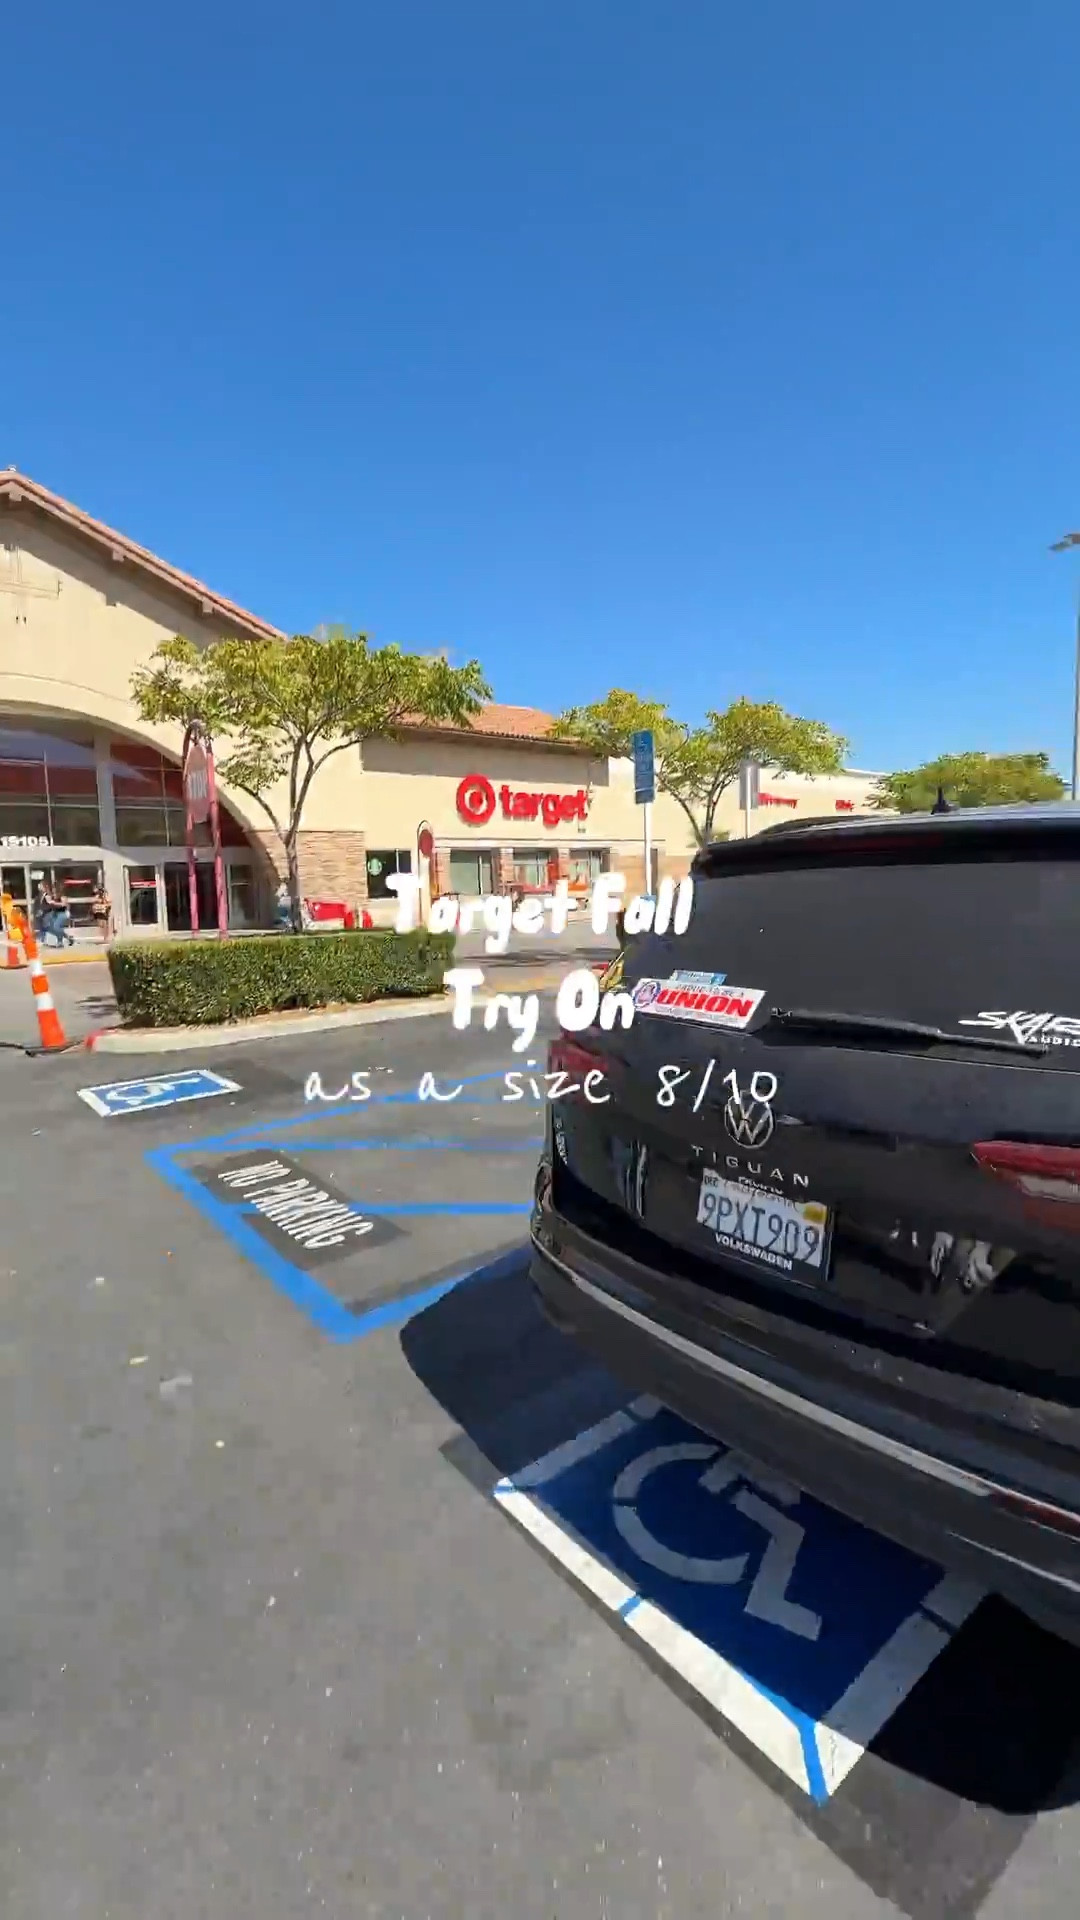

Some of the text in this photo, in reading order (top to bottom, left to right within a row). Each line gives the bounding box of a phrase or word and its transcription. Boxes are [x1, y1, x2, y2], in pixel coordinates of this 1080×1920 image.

[500, 785, 589, 827] target
[656, 988, 754, 1017] UNION
[690, 1144, 810, 1188] TIGUAN
[217, 1160, 374, 1249] NO PARKING
[703, 1193, 820, 1262] 9PXT909
[715, 1232, 793, 1271] VOLKSWAGEN
